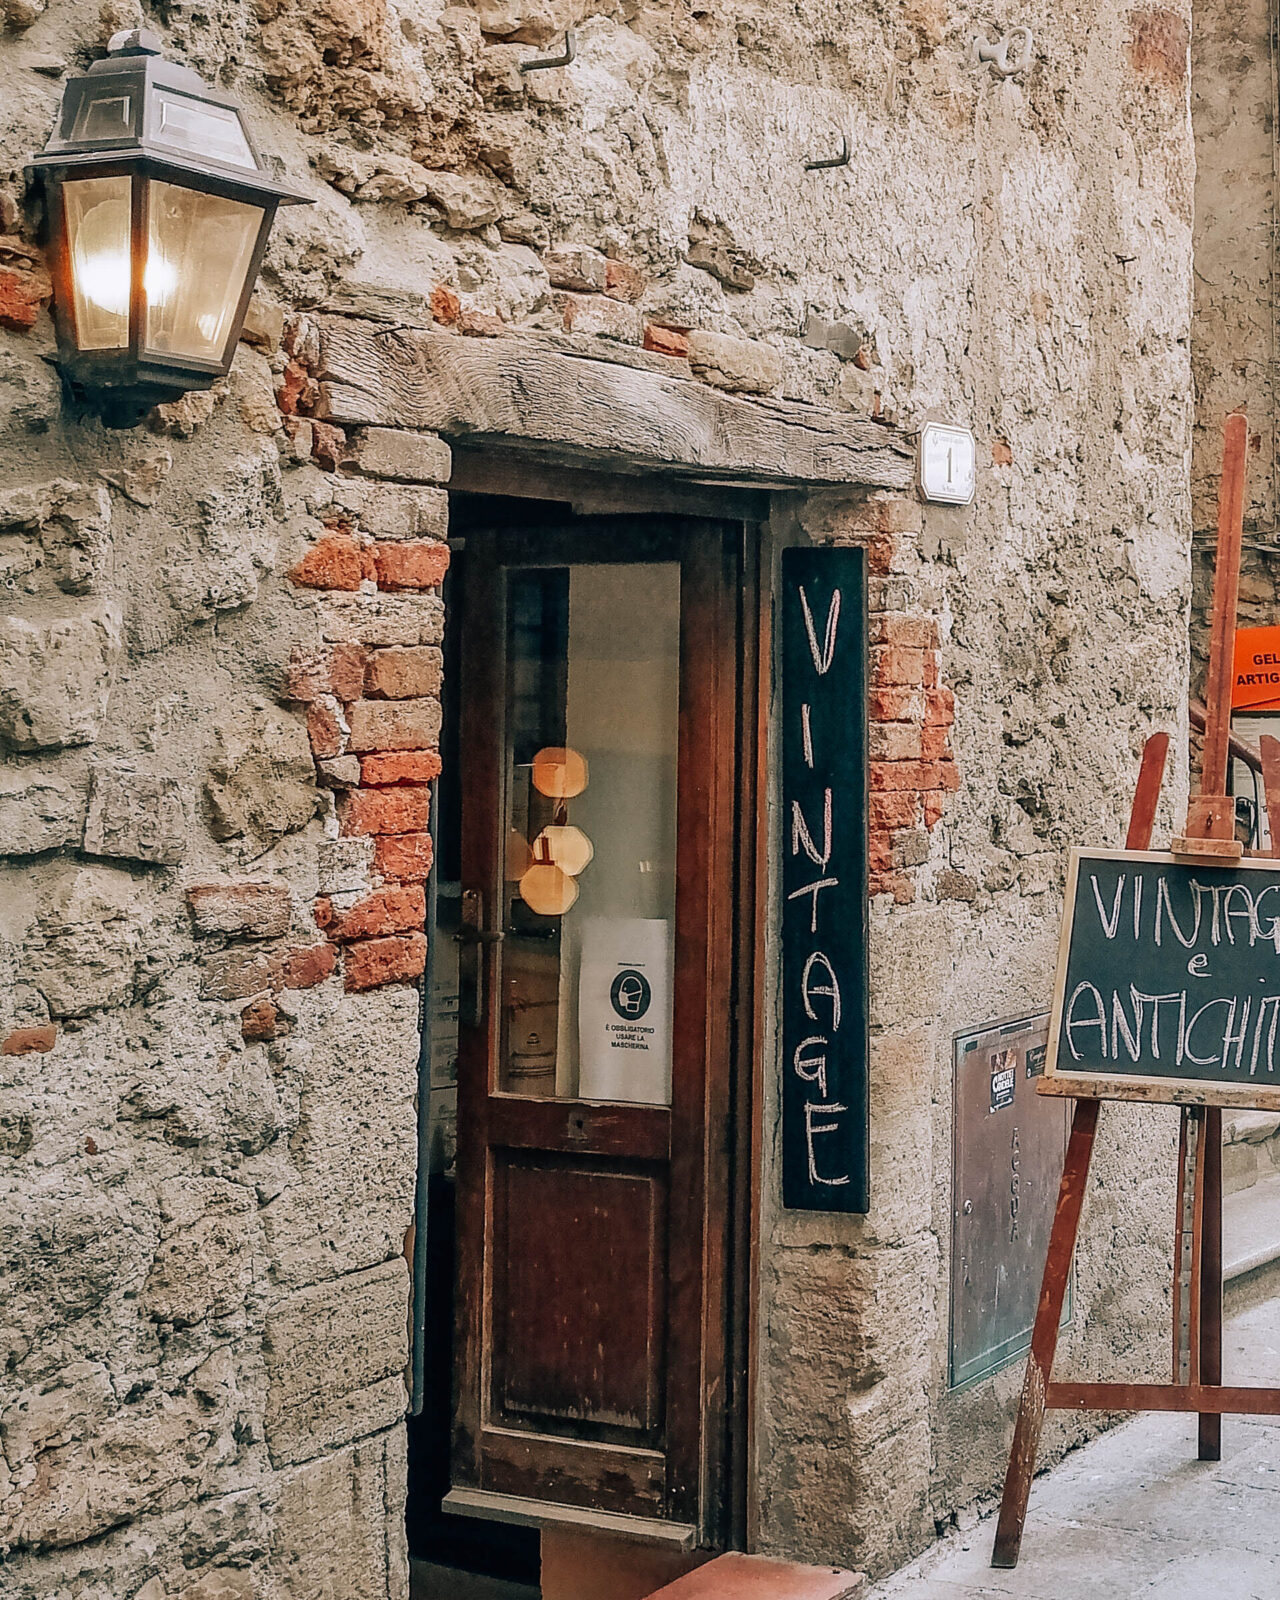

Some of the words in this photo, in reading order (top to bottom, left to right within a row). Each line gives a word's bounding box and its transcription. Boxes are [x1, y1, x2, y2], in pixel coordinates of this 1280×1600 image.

[788, 585, 850, 1186] VINTAGE
[611, 1025, 654, 1034] OBBLIGATORIO
[615, 1033, 636, 1041] USARE
[611, 1041, 649, 1050] MASCHERINA
